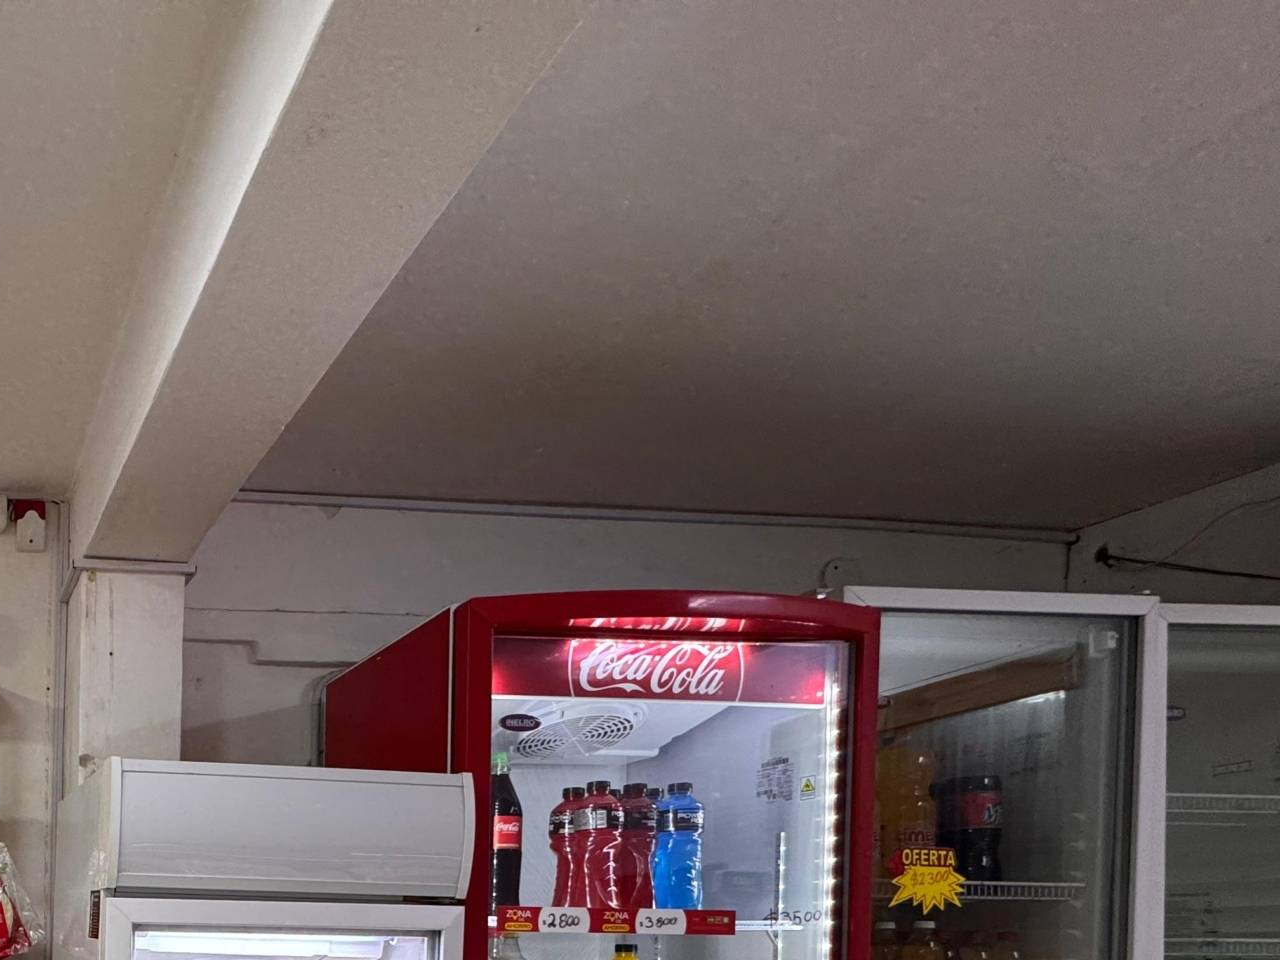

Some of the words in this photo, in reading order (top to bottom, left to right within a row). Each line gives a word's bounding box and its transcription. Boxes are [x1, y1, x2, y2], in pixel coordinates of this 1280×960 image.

[902, 848, 955, 866] OFERTA
[506, 910, 531, 921] ZONA
[603, 911, 629, 922] ZONA
